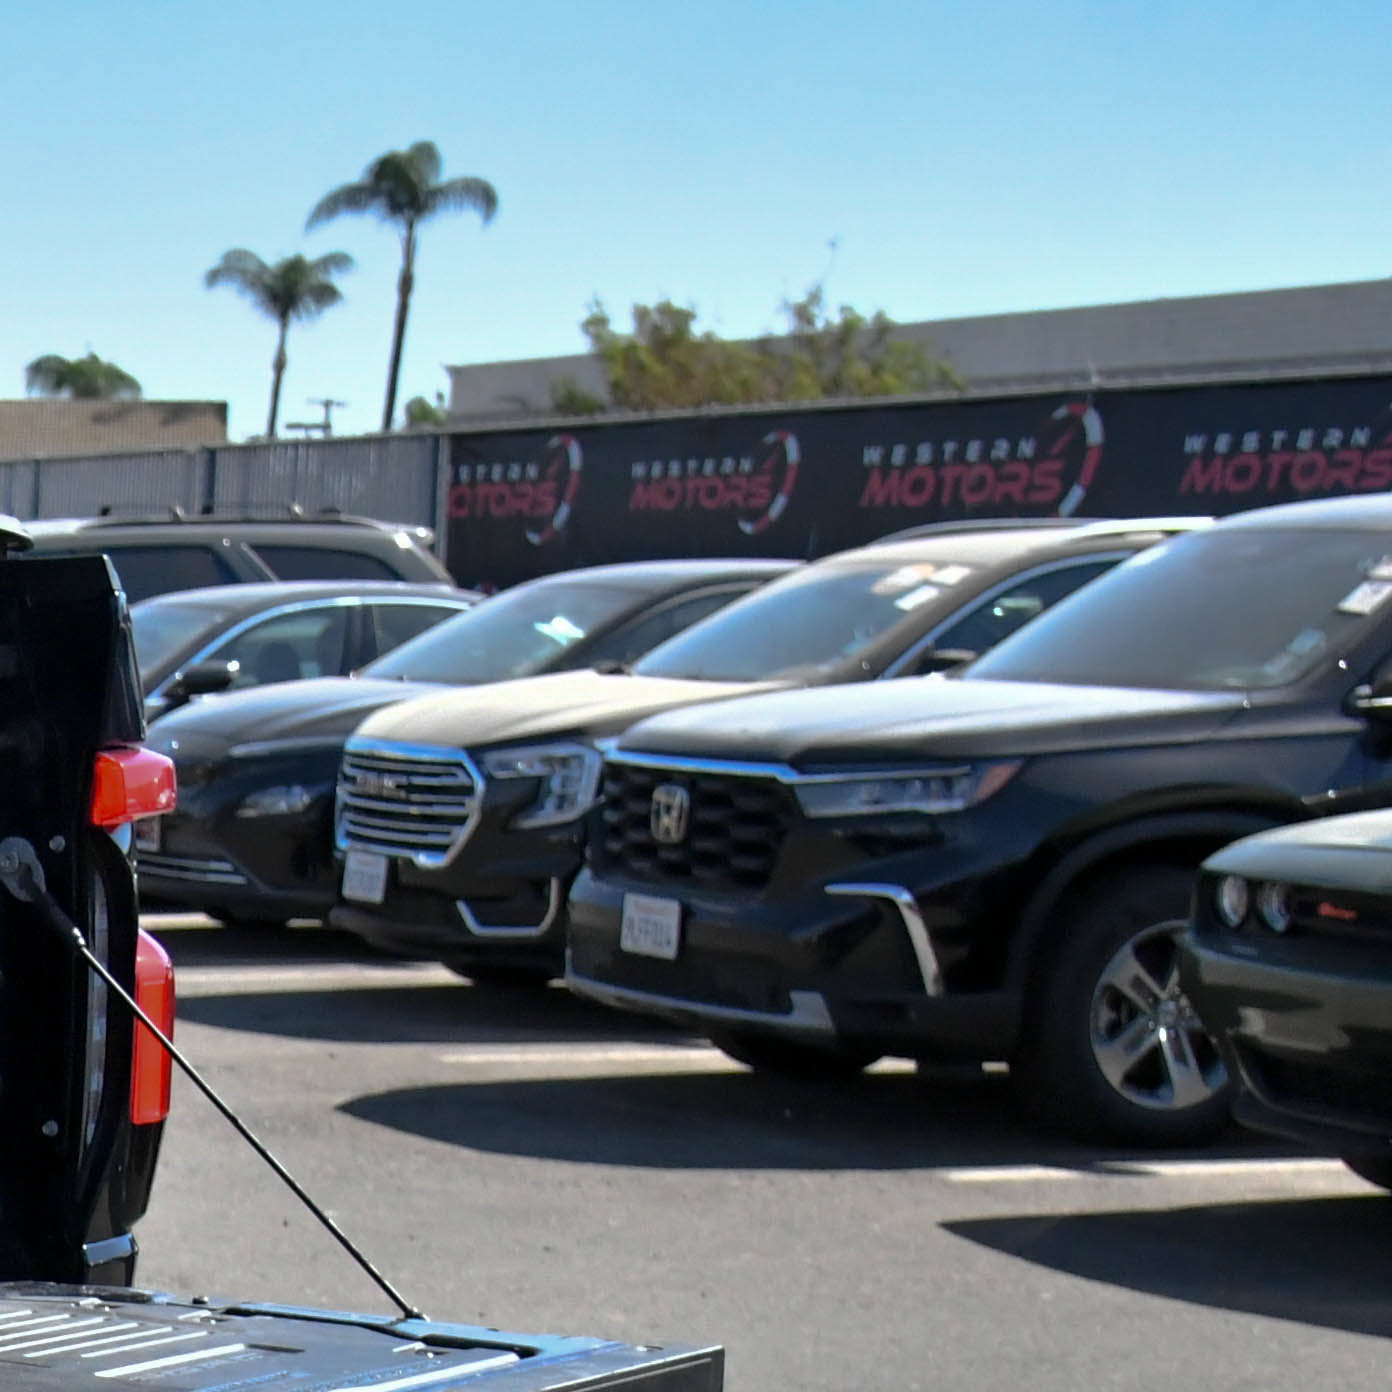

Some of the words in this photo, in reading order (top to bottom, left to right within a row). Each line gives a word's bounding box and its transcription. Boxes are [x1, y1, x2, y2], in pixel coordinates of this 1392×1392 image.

[863, 436, 1037, 466] WESTERN
[1183, 427, 1372, 454] WESTERN
[456, 462, 540, 484] STERN
[632, 457, 753, 478] WESTERN
[859, 459, 1065, 507] MOTORS
[1179, 449, 1392, 494] MOTORS
[447, 482, 558, 517] OTORS
[629, 473, 773, 512] MOTORS
